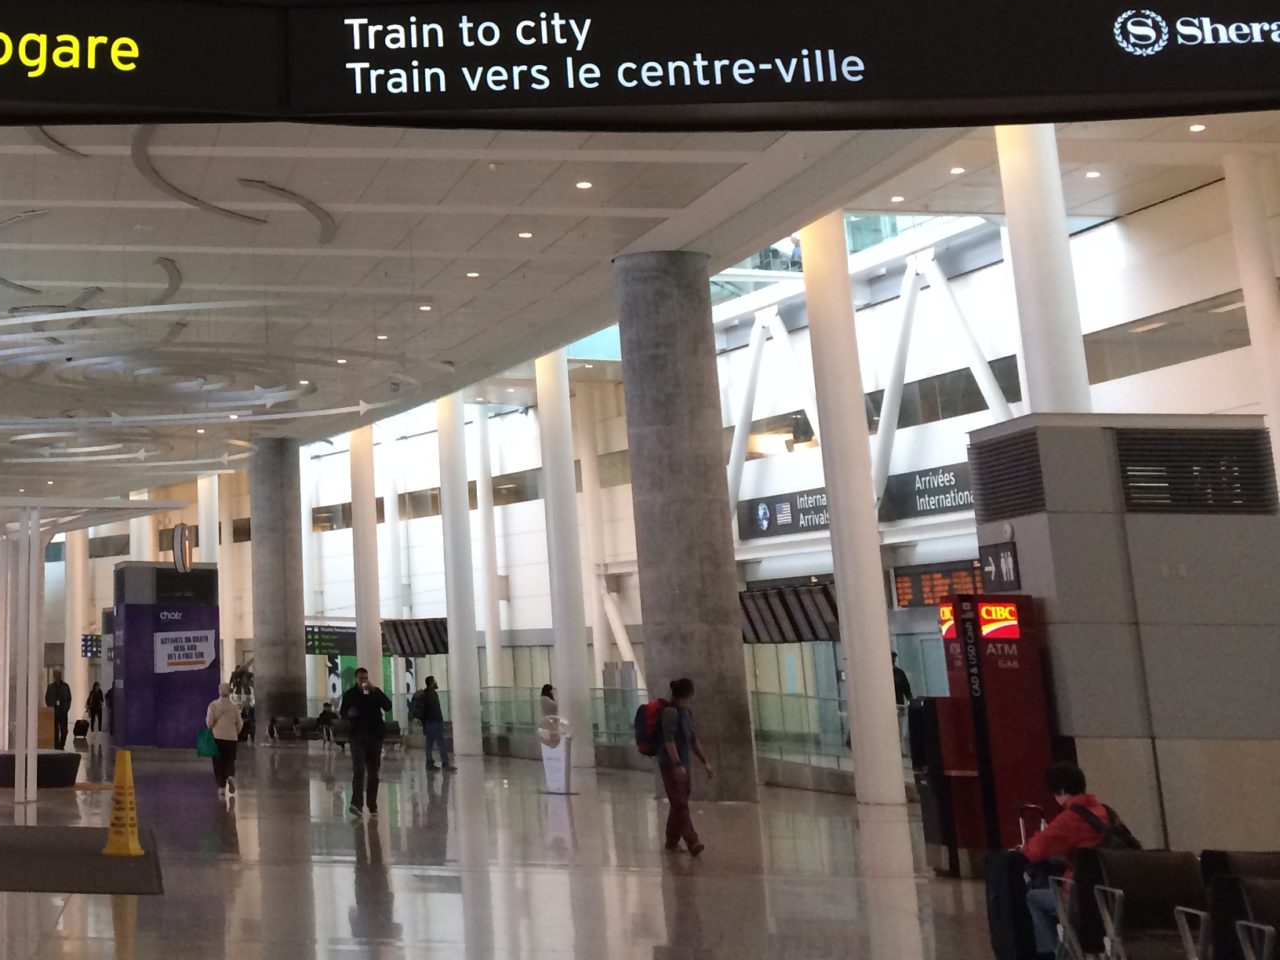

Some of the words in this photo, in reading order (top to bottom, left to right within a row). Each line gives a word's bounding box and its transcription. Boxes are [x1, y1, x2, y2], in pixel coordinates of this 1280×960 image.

[344, 16, 444, 50] Train
[459, 16, 500, 47] to
[516, 12, 592, 51] city
[346, 59, 446, 94] Train
[462, 64, 549, 92] vers
[567, 57, 601, 89] le
[618, 49, 865, 87] centre-ville
[915, 469, 956, 490] Arrivées
[981, 606, 1016, 620] CIBC
[986, 644, 1018, 655] ATM
[971, 676, 982, 696] CAD
